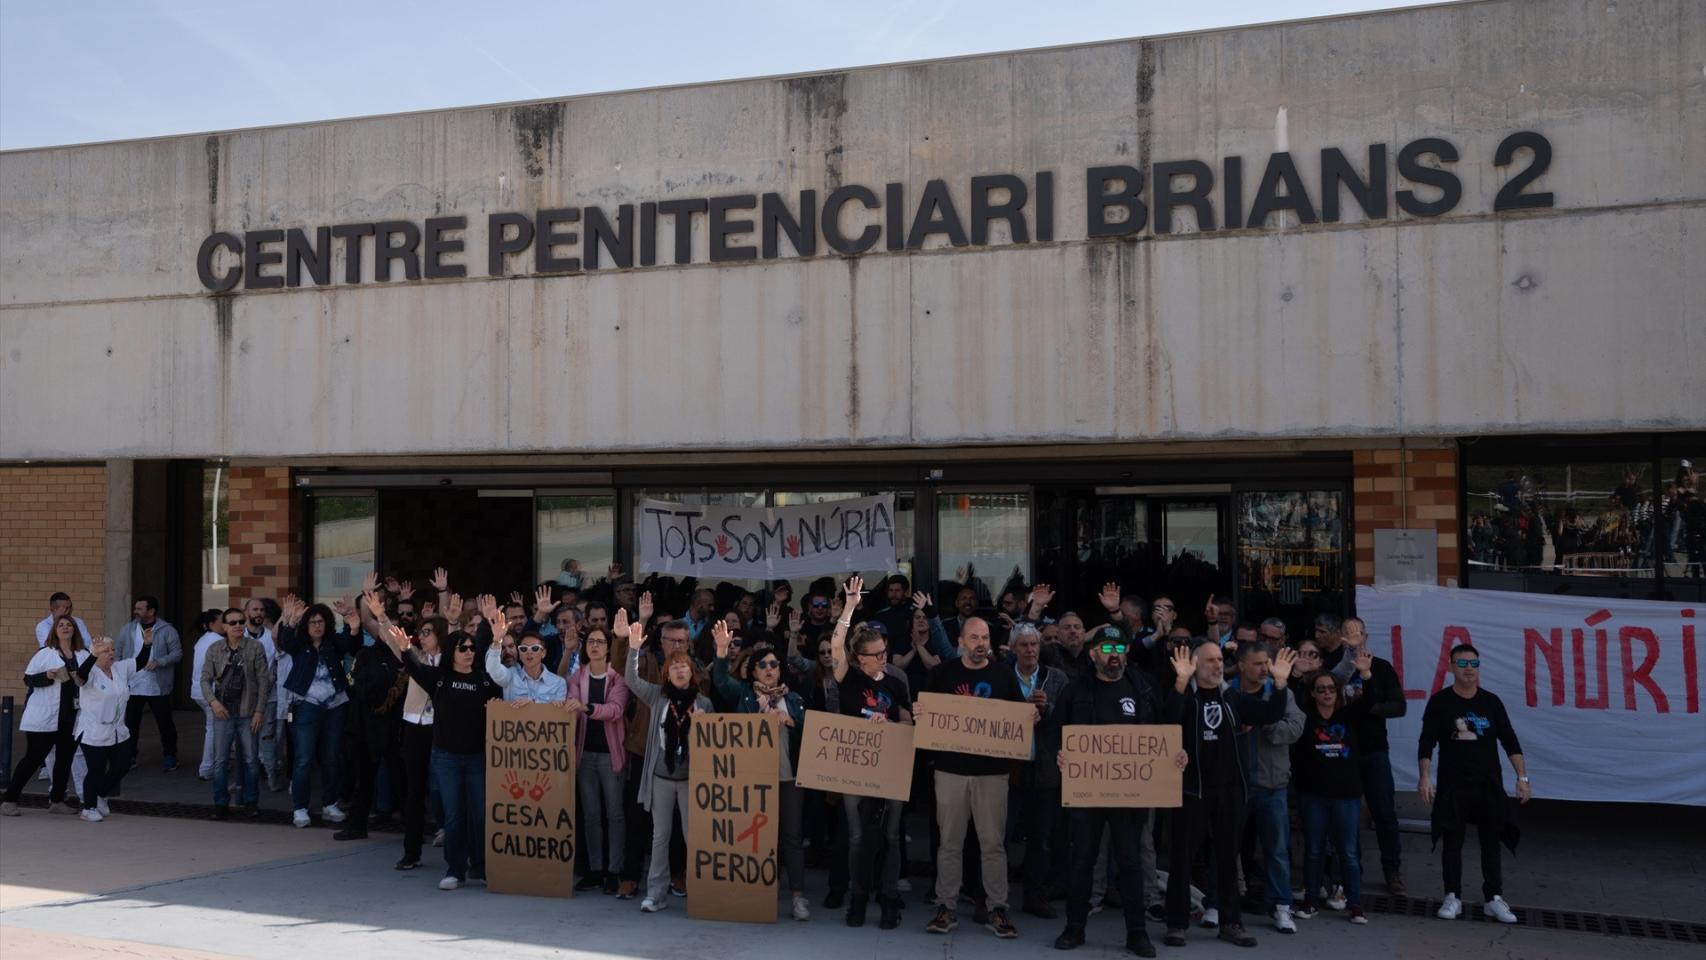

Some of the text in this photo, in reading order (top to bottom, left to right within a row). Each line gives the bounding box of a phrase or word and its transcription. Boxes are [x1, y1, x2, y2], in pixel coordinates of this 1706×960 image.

[197, 131, 1554, 291] CENTRE PENITENCIARI BRIANS 2
[799, 503, 894, 557] NÚRIA
[492, 719, 571, 744] UBASART
[696, 716, 774, 749] NÚRIA
[818, 726, 884, 749] CALDERÓ
[928, 711, 1025, 743] TOTS SOM NÚRIA
[491, 745, 570, 773] DIMISSIÓ
[816, 746, 882, 768] A PRESÓ
[1065, 733, 1169, 758] CONSELLERA
[712, 754, 736, 779] NI
[1068, 759, 1155, 782] DIMISSIÓ
[696, 783, 772, 814] OBLIT
[492, 803, 573, 830] CESA A
[712, 818, 735, 846] NI
[491, 831, 574, 863] CALDERÓ
[696, 848, 777, 887] PERDÓ
